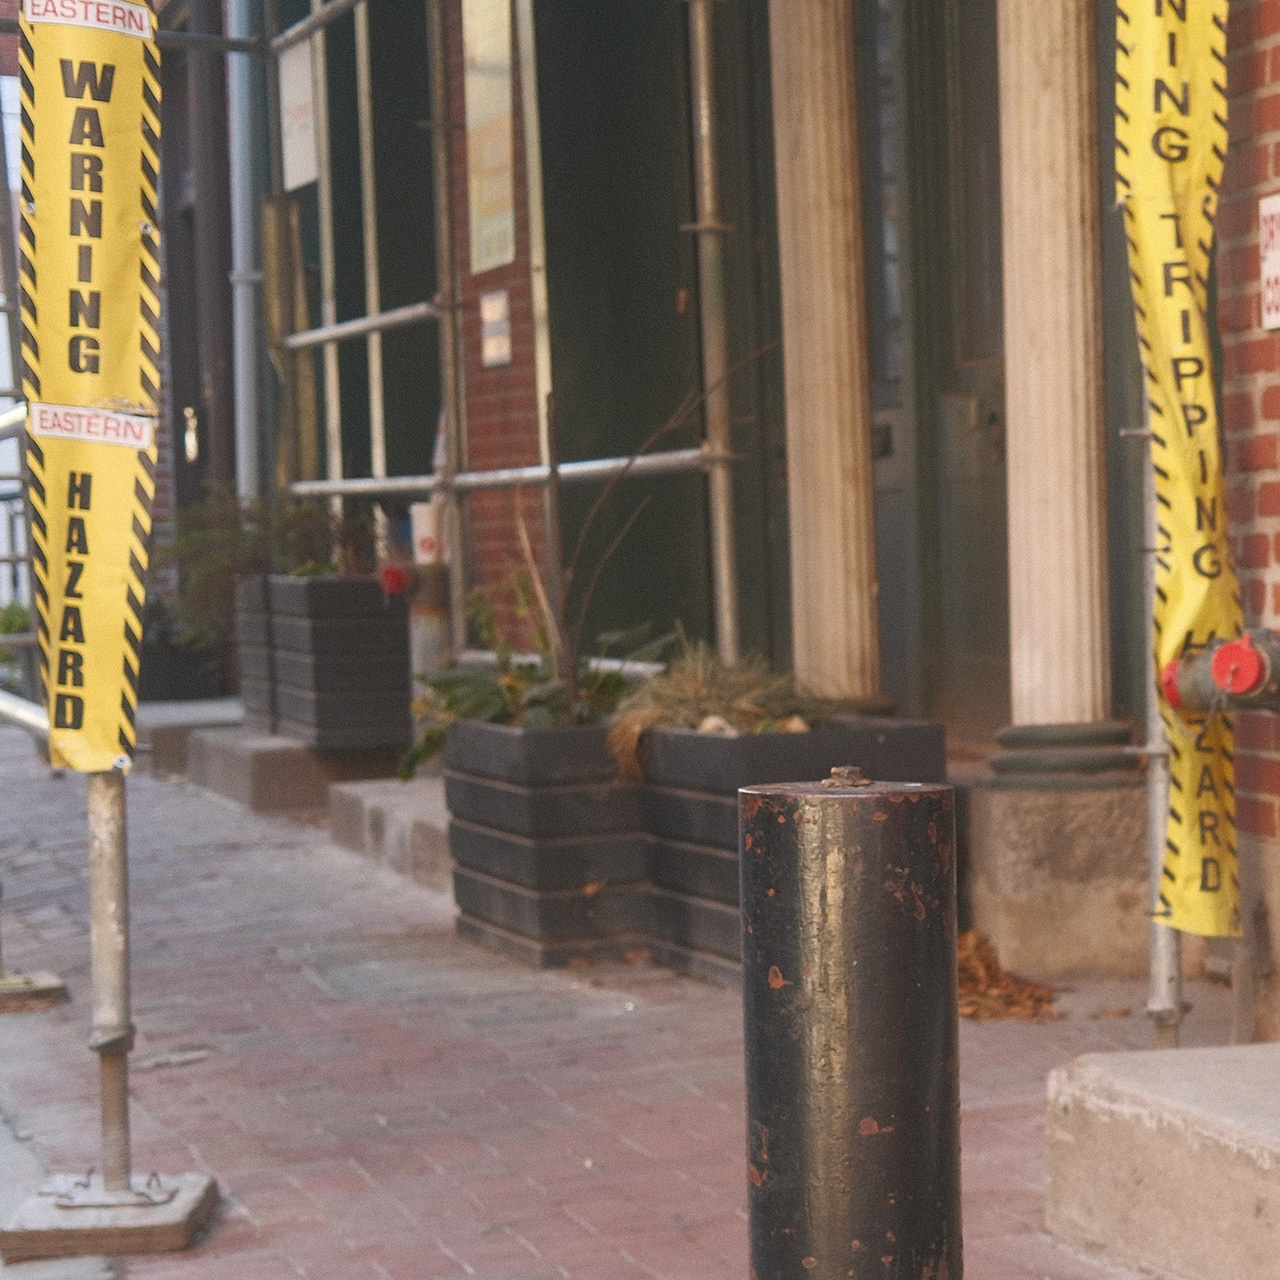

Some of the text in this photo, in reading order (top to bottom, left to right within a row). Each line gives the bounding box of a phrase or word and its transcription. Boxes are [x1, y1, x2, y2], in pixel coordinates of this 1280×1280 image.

[30, 0, 144, 31] EASTERN
[59, 58, 116, 375] WARNING
[38, 408, 145, 441] EASTERN
[54, 472, 92, 731] HAZARD
[1180, 630, 1222, 892] HZARD
